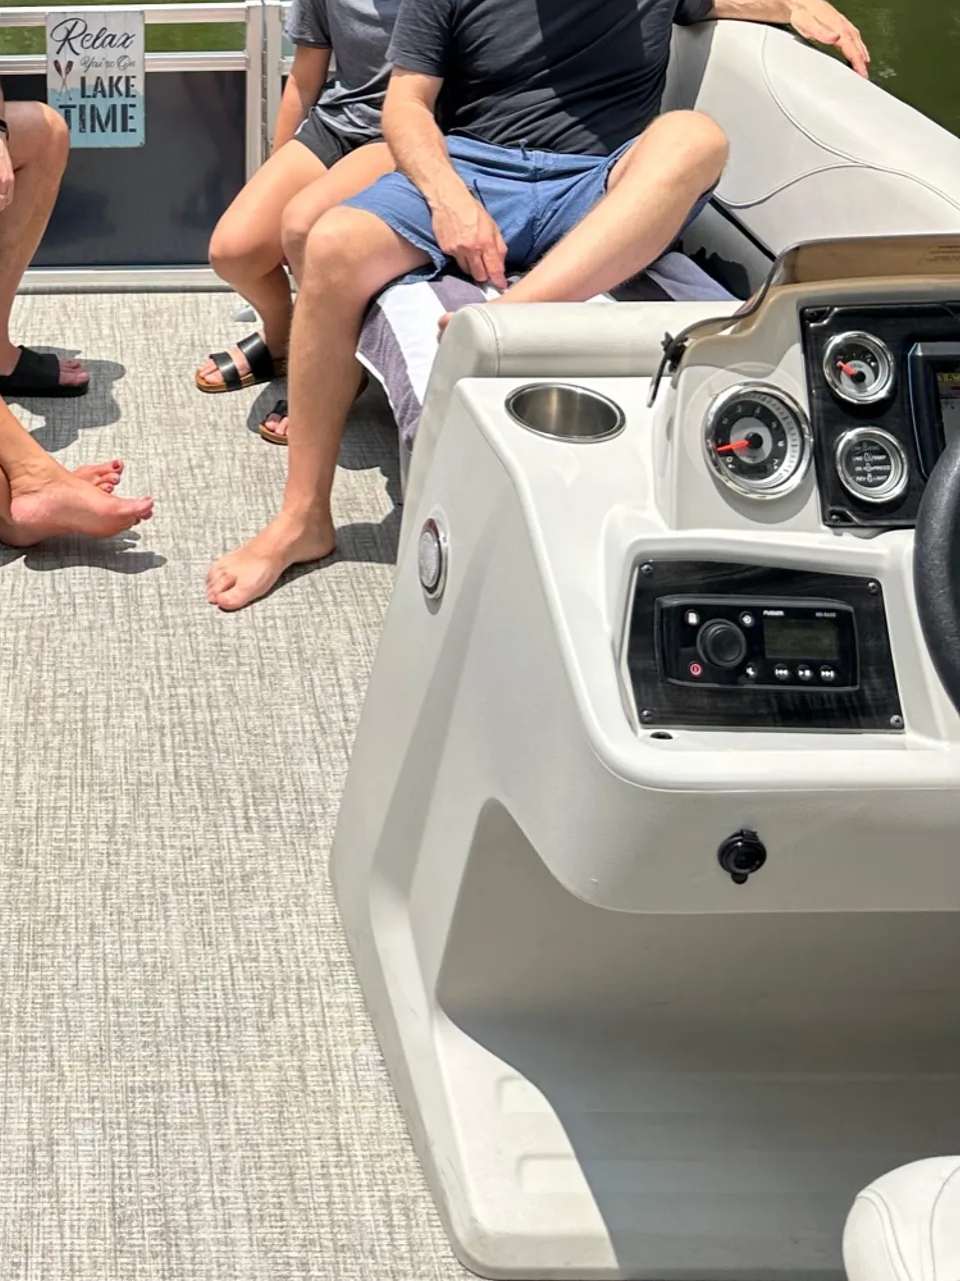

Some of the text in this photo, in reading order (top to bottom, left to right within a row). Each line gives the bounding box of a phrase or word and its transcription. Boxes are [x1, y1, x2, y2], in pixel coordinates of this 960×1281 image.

[50, 18, 136, 56] Relax
[80, 55, 136, 73] You're On
[80, 75, 137, 99] LAKE
[58, 104, 137, 133] TIME
